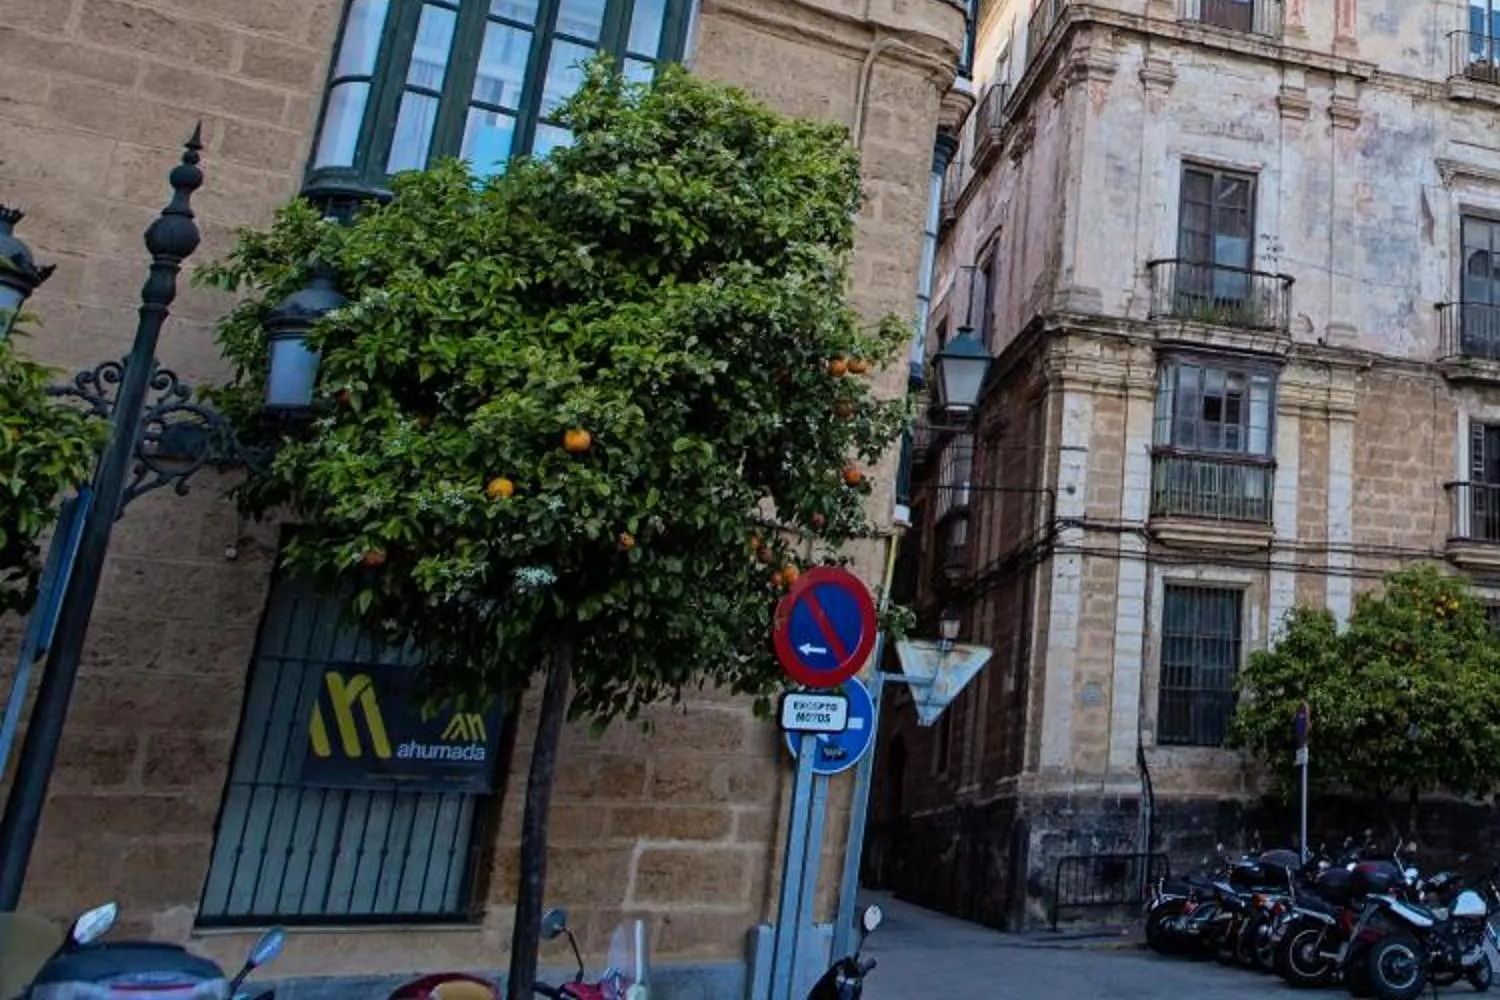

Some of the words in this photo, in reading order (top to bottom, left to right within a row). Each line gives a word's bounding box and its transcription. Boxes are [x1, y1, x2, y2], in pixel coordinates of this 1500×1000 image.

[794, 702, 838, 712] EXCEPTO
[796, 712, 831, 723] MOTOS
[397, 740, 485, 761] ahumada
